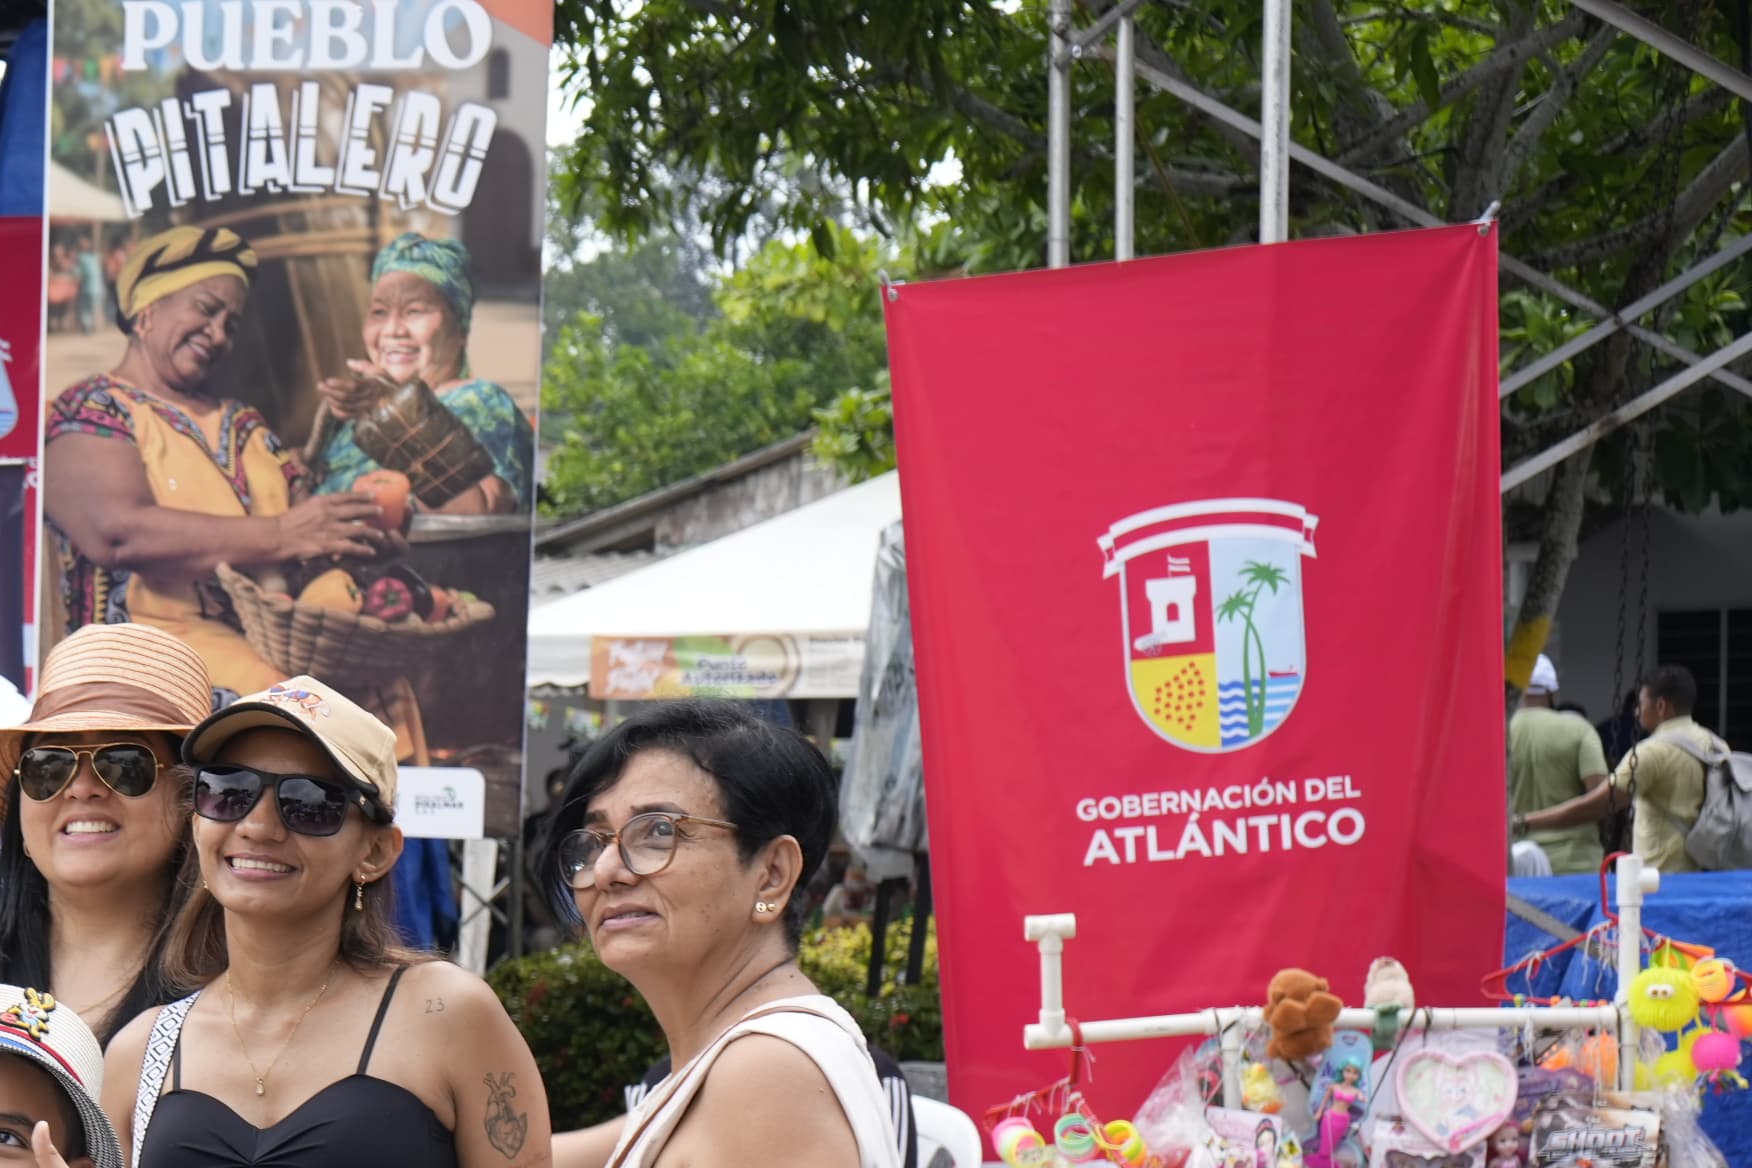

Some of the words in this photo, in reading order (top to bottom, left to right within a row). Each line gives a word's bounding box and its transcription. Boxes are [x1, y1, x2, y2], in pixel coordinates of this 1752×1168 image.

[120, 0, 493, 71] PUEBLO
[105, 81, 498, 220] PITALERO
[1075, 777, 1297, 822] GOBERNACIÓN
[1304, 775, 1362, 801] DEL
[1083, 807, 1366, 867] ATLÁNTICO
